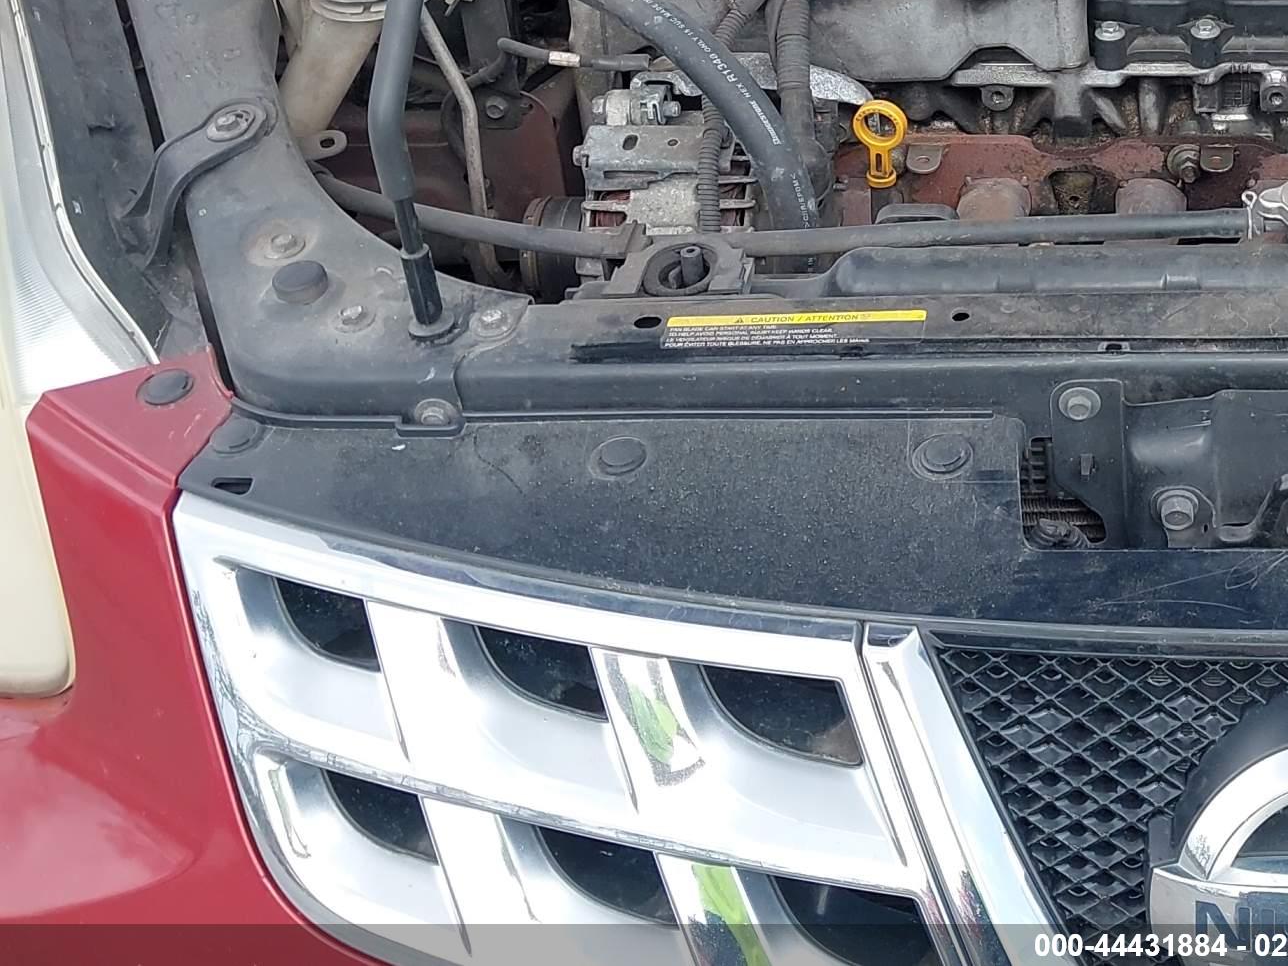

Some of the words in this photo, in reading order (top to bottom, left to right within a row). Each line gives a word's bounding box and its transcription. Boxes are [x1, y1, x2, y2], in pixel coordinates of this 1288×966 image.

[651, 3, 672, 18] MADE
[691, 36, 711, 53] ONLY
[735, 83, 752, 99] HEX
[751, 316, 794, 324] CAUTION
[805, 314, 858, 322] ATTENTION
